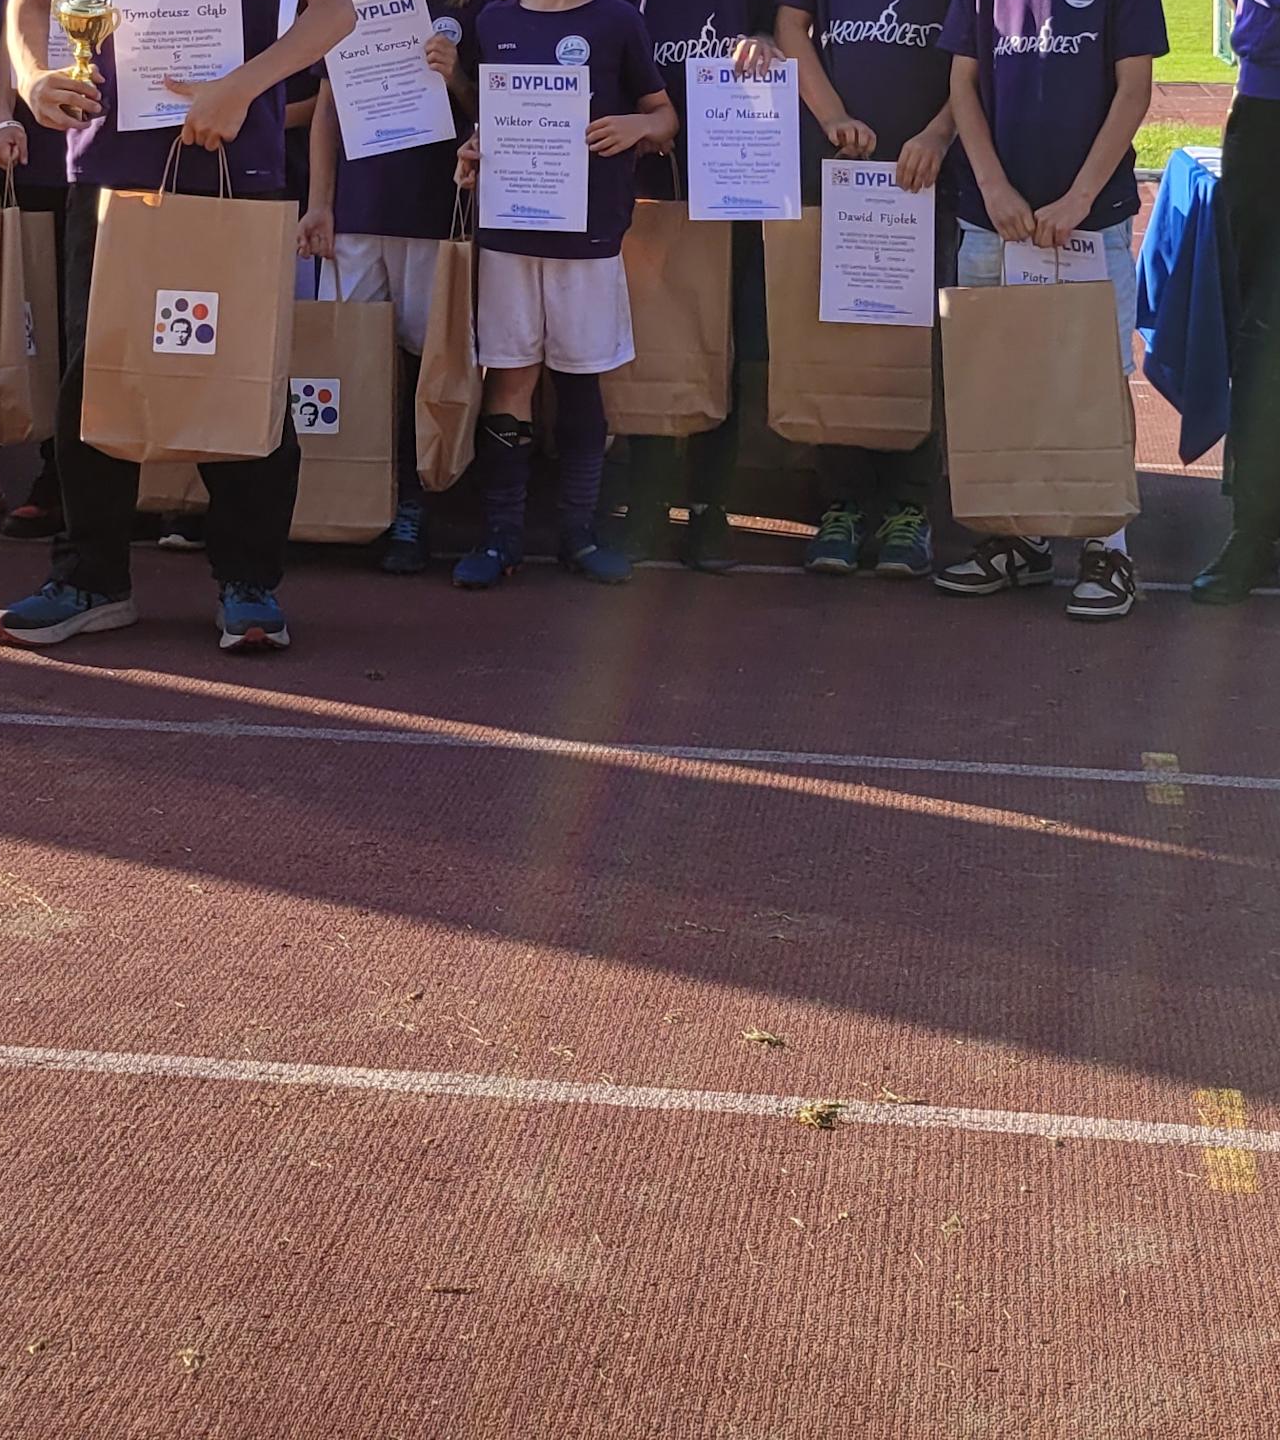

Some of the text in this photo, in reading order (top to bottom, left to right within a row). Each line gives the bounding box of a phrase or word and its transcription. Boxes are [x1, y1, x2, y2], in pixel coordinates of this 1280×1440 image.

[122, 4, 227, 22] Tymoteusz Głąb
[340, 35, 420, 60] Karol Korczyk
[654, 32, 738, 66] KROPROCE
[993, 30, 1086, 56] AKROPROCES
[512, 76, 577, 91] DYPLOM
[494, 116, 570, 128] Wiktor Graca
[705, 108, 780, 122] Olaf Miszuta
[856, 172, 897, 187] DYPL
[838, 211, 917, 226] Dawid Fijołek
[1062, 239, 1094, 255] LOM
[1022, 271, 1049, 283] Piotr
